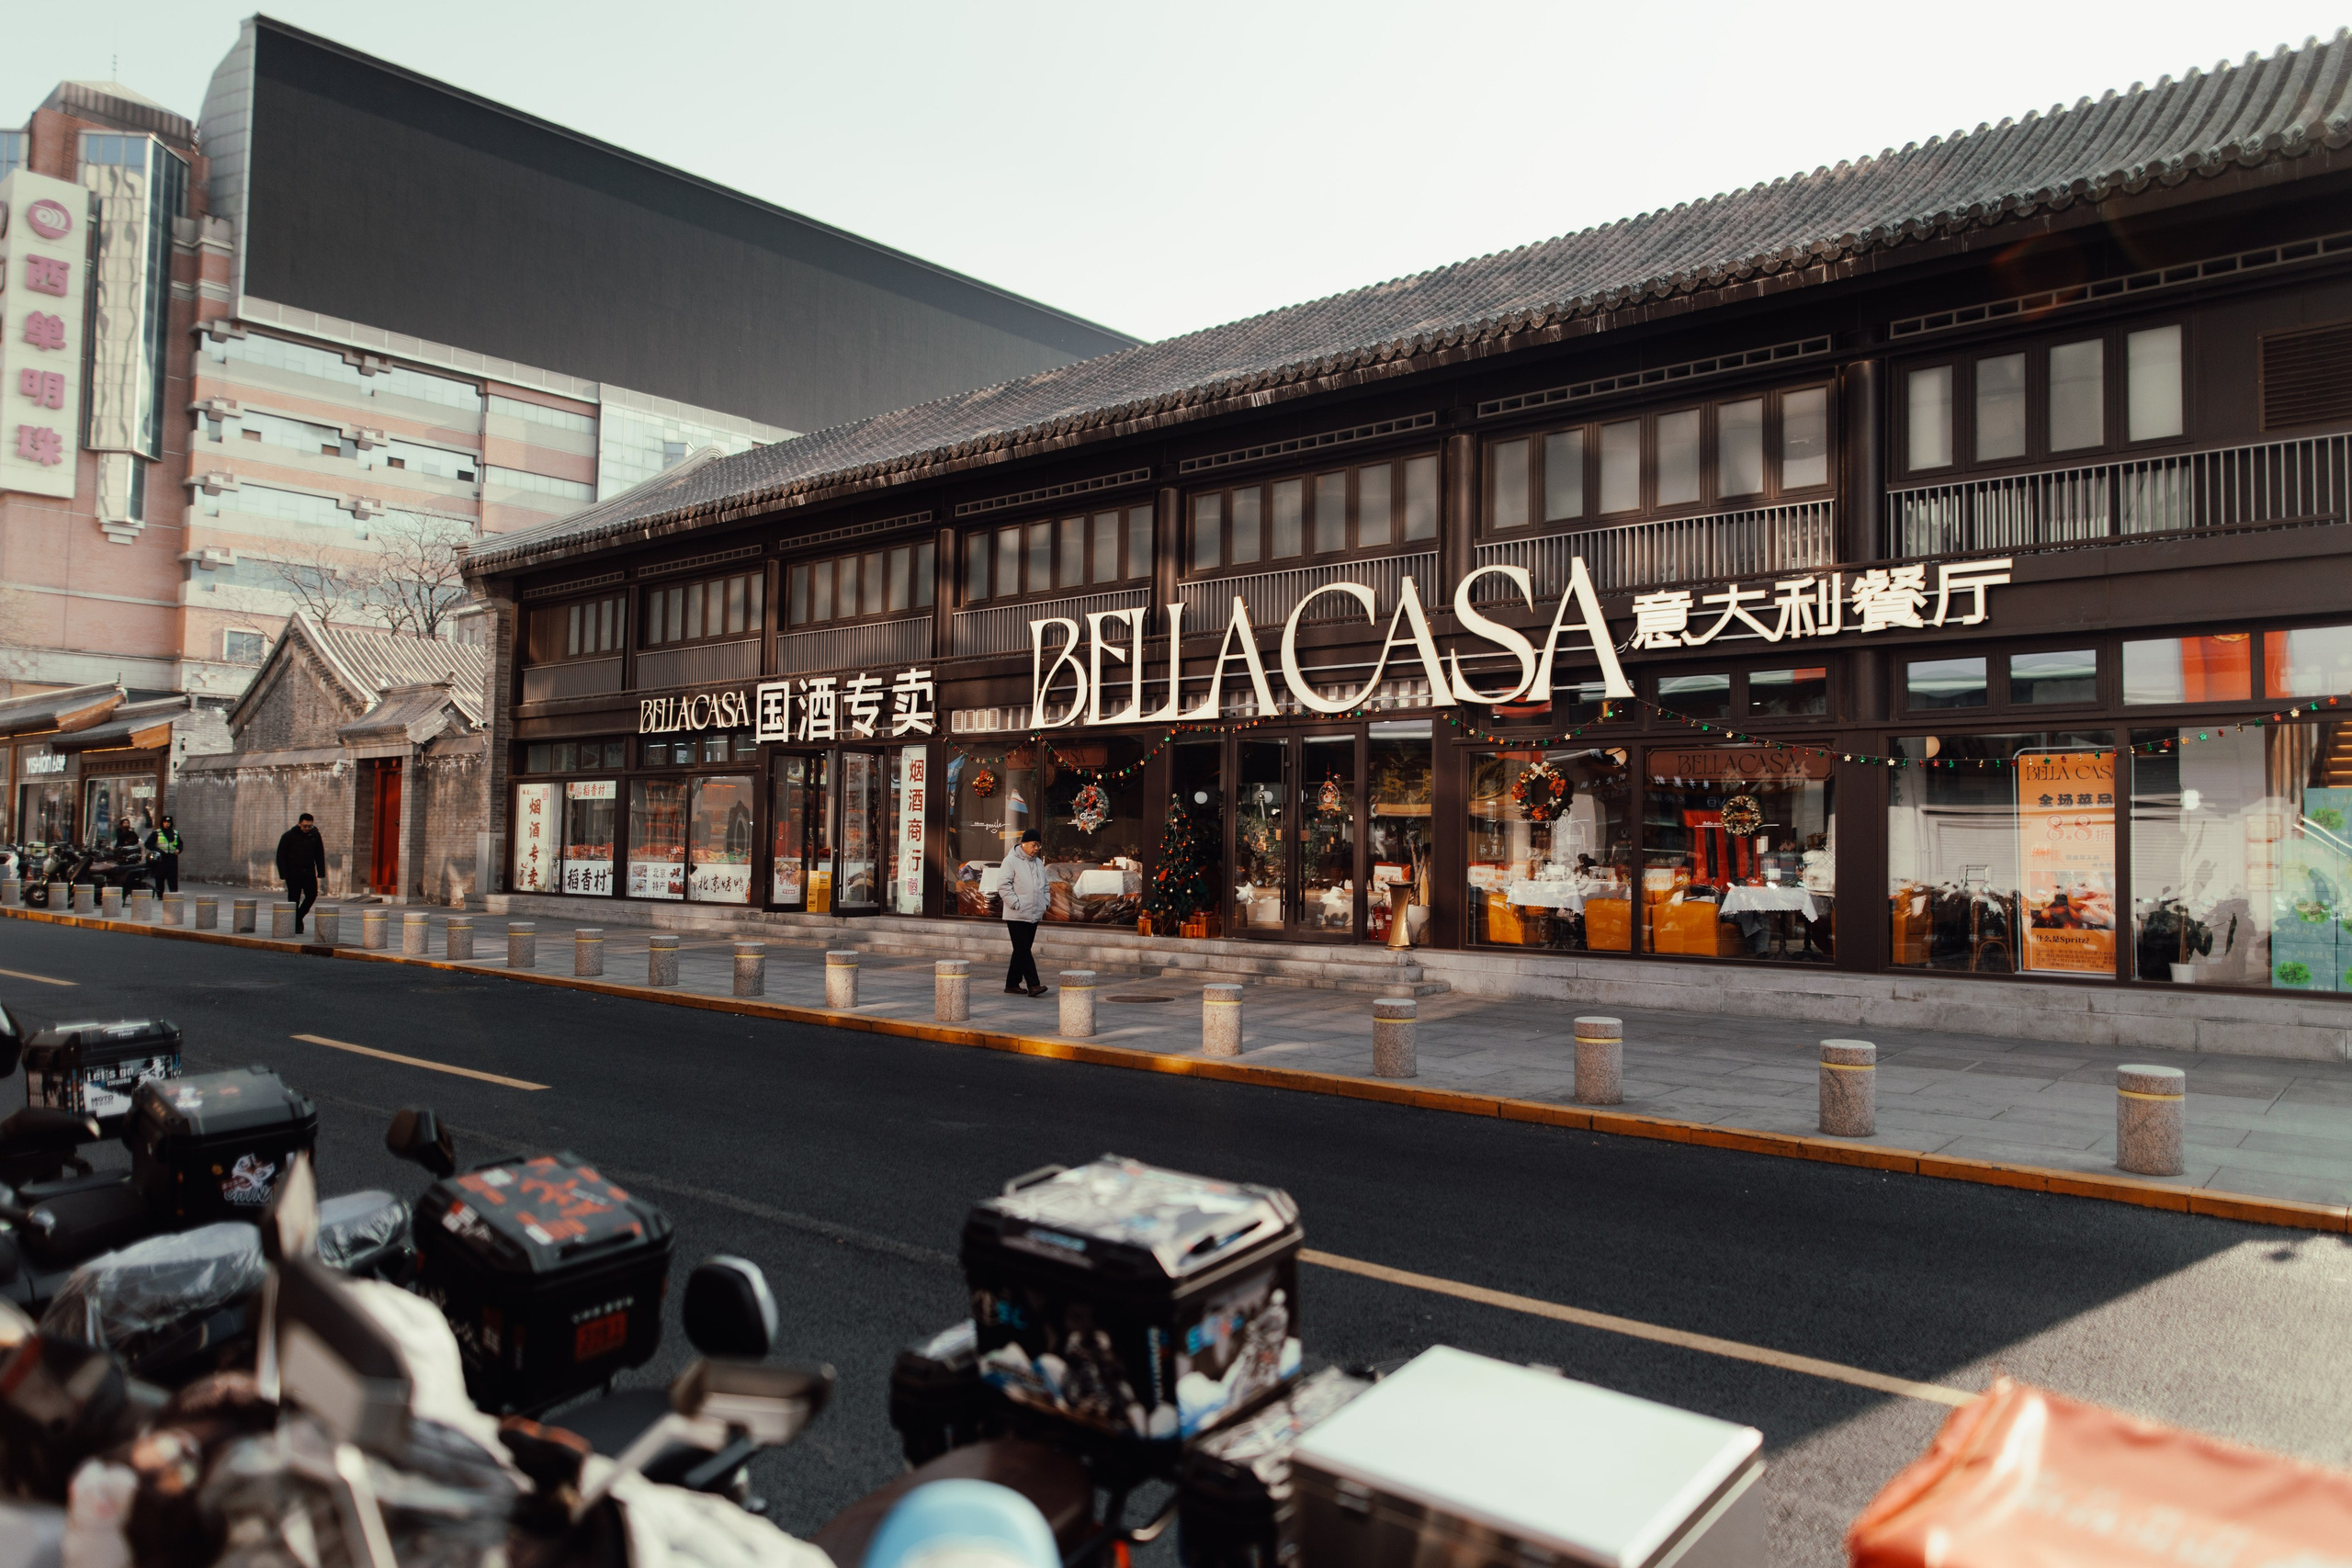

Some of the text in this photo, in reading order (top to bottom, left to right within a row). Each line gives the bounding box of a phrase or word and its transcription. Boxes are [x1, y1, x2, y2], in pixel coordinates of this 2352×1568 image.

[16, 254, 70, 467] 西单明珠
[1029, 556, 2012, 729] BELLACASA 意大利餐厅
[756, 668, 933, 744] 国酒专卖
[2026, 764, 2113, 780] BELLA CAS
[583, 784, 605, 796] 稻香村
[2039, 794, 2113, 807] 全场菜品
[907, 759, 924, 872] 烟酒商行
[527, 797, 541, 887] 烟酒专卖
[567, 868, 606, 892] 稻香村
[653, 868, 666, 878] 北京
[652, 881, 666, 892] 特产
